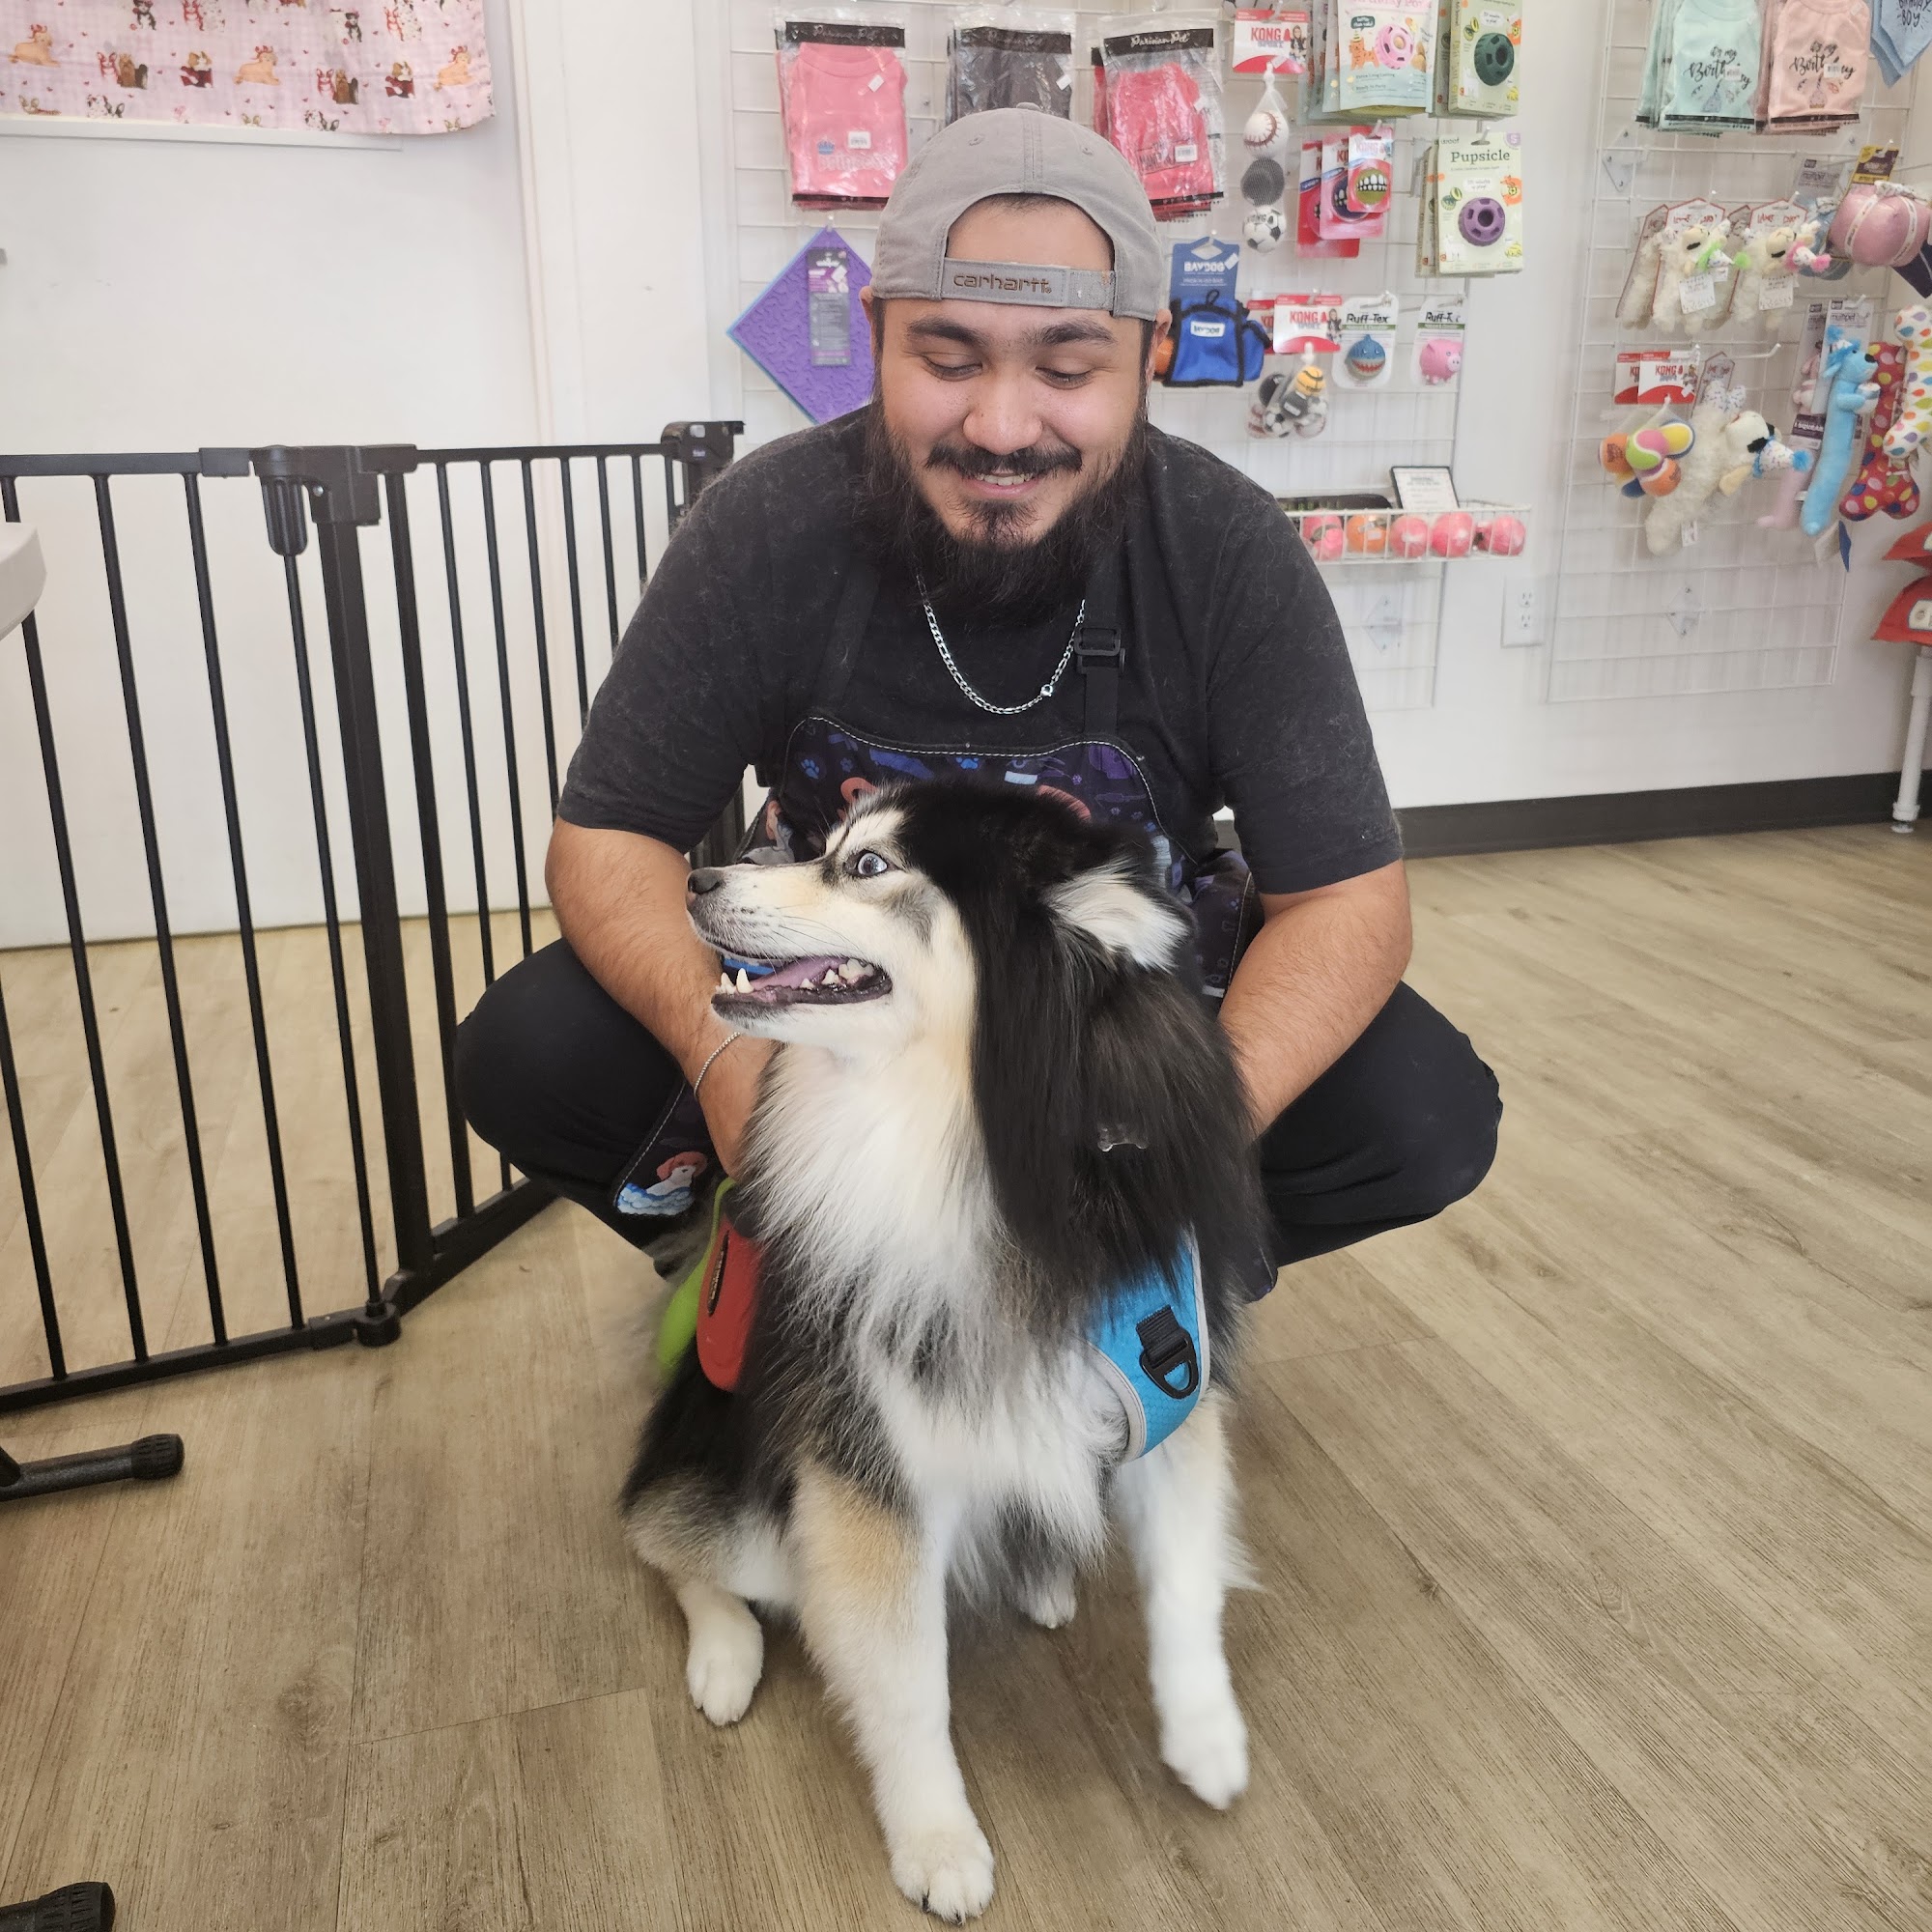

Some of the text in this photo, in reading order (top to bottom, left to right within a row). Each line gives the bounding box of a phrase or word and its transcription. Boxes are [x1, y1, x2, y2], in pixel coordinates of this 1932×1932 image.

[1902, 10, 1920, 27] BOY
[1251, 27, 1282, 42] KONG
[1450, 149, 1510, 165] Pupsicle
[1183, 261, 1226, 272] BAYDOG
[953, 273, 1050, 294] carhartt
[1290, 311, 1319, 324] KONG
[1346, 312, 1389, 324] Ruff-Tex
[1655, 364, 1677, 377] KONG
